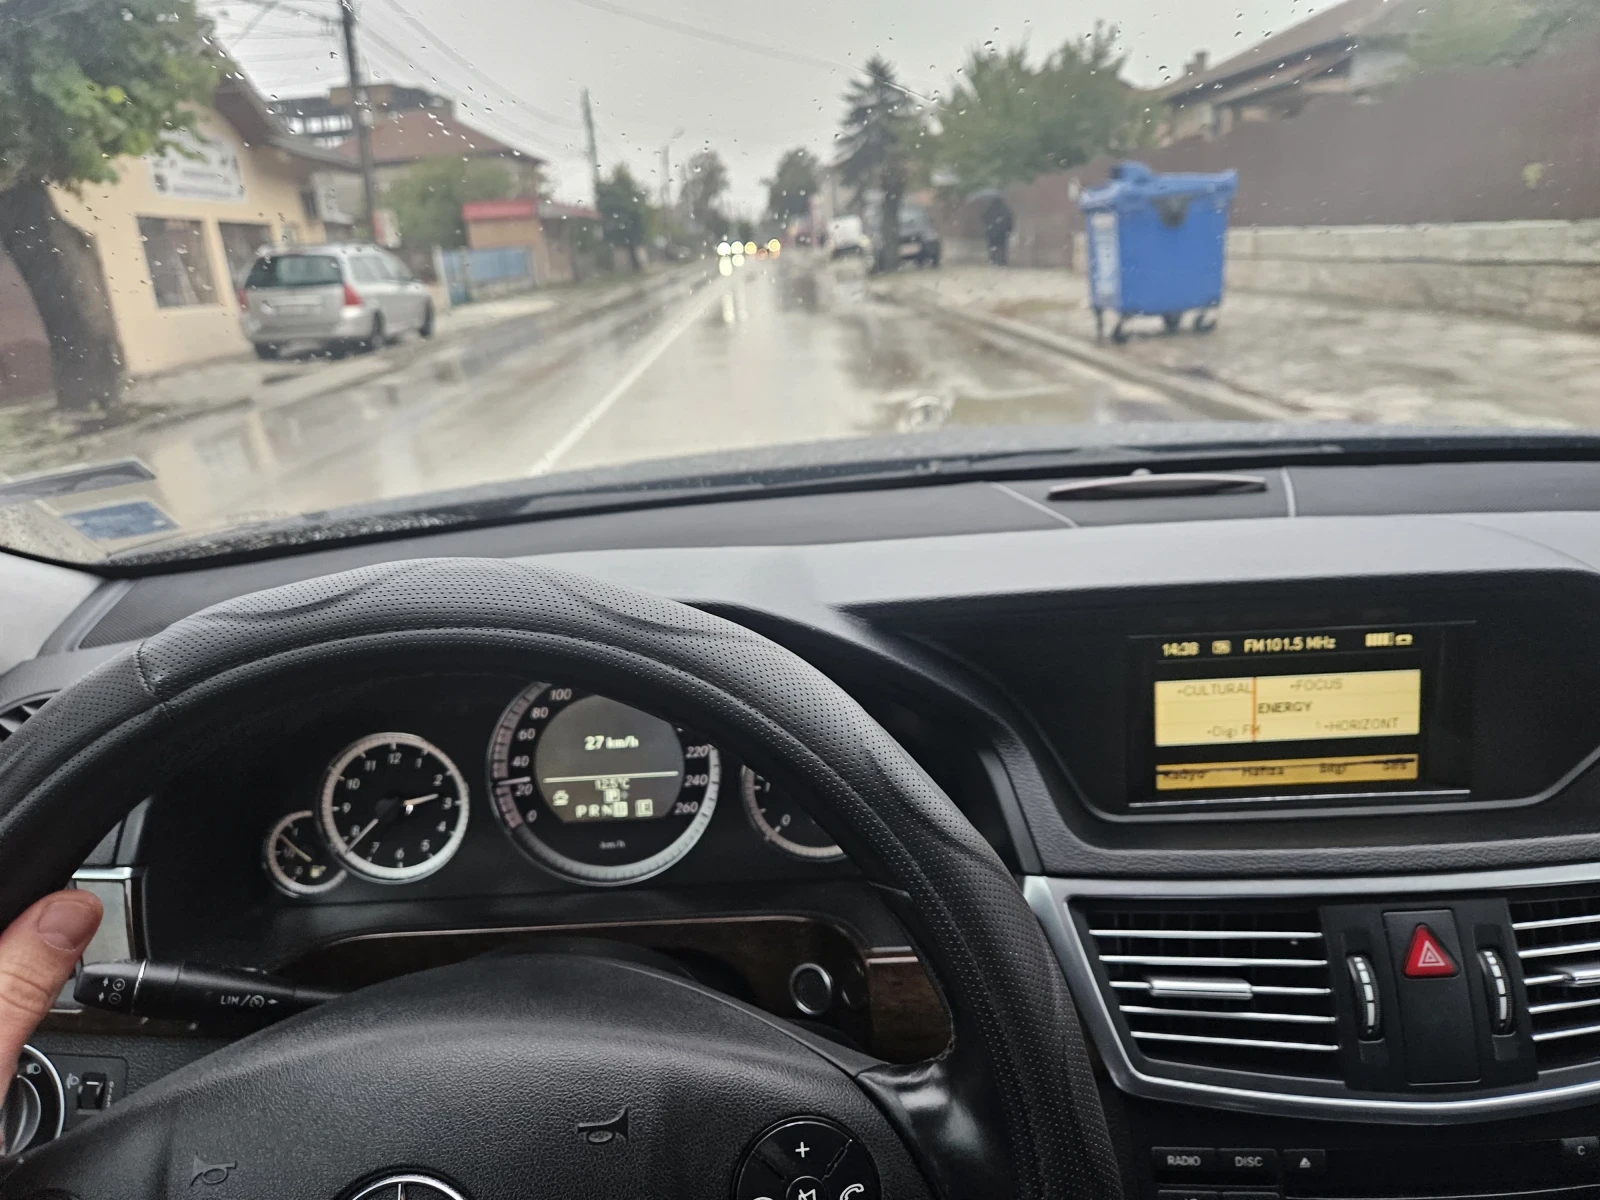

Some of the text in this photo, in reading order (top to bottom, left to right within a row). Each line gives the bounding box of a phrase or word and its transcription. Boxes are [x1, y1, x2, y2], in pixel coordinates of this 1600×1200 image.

[1305, 634, 1337, 650] MHz
[551, 688, 572, 700] 100
[531, 706, 549, 719] 80
[1257, 700, 1313, 715] ENERGY
[518, 728, 536, 740] 60
[584, 735, 639, 751] 27 km/h
[686, 745, 709, 758] 220
[388, 752, 402, 765] 12
[415, 757, 423, 769] 1
[512, 755, 530, 768] 40
[364, 760, 377, 771] 11
[346, 777, 361, 790] 10
[433, 773, 444, 786] 2
[685, 774, 708, 786] 240
[516, 783, 533, 796] 20
[442, 797, 453, 810] 3
[675, 801, 699, 814] 260
[527, 809, 537, 823] 0
[575, 804, 588, 818] P
[588, 803, 600, 817] R
[781, 813, 791, 827] 0
[1577, 1145, 1586, 1155] C
[1166, 1154, 1201, 1167] RADIO
[1234, 1155, 1264, 1168] DISC
